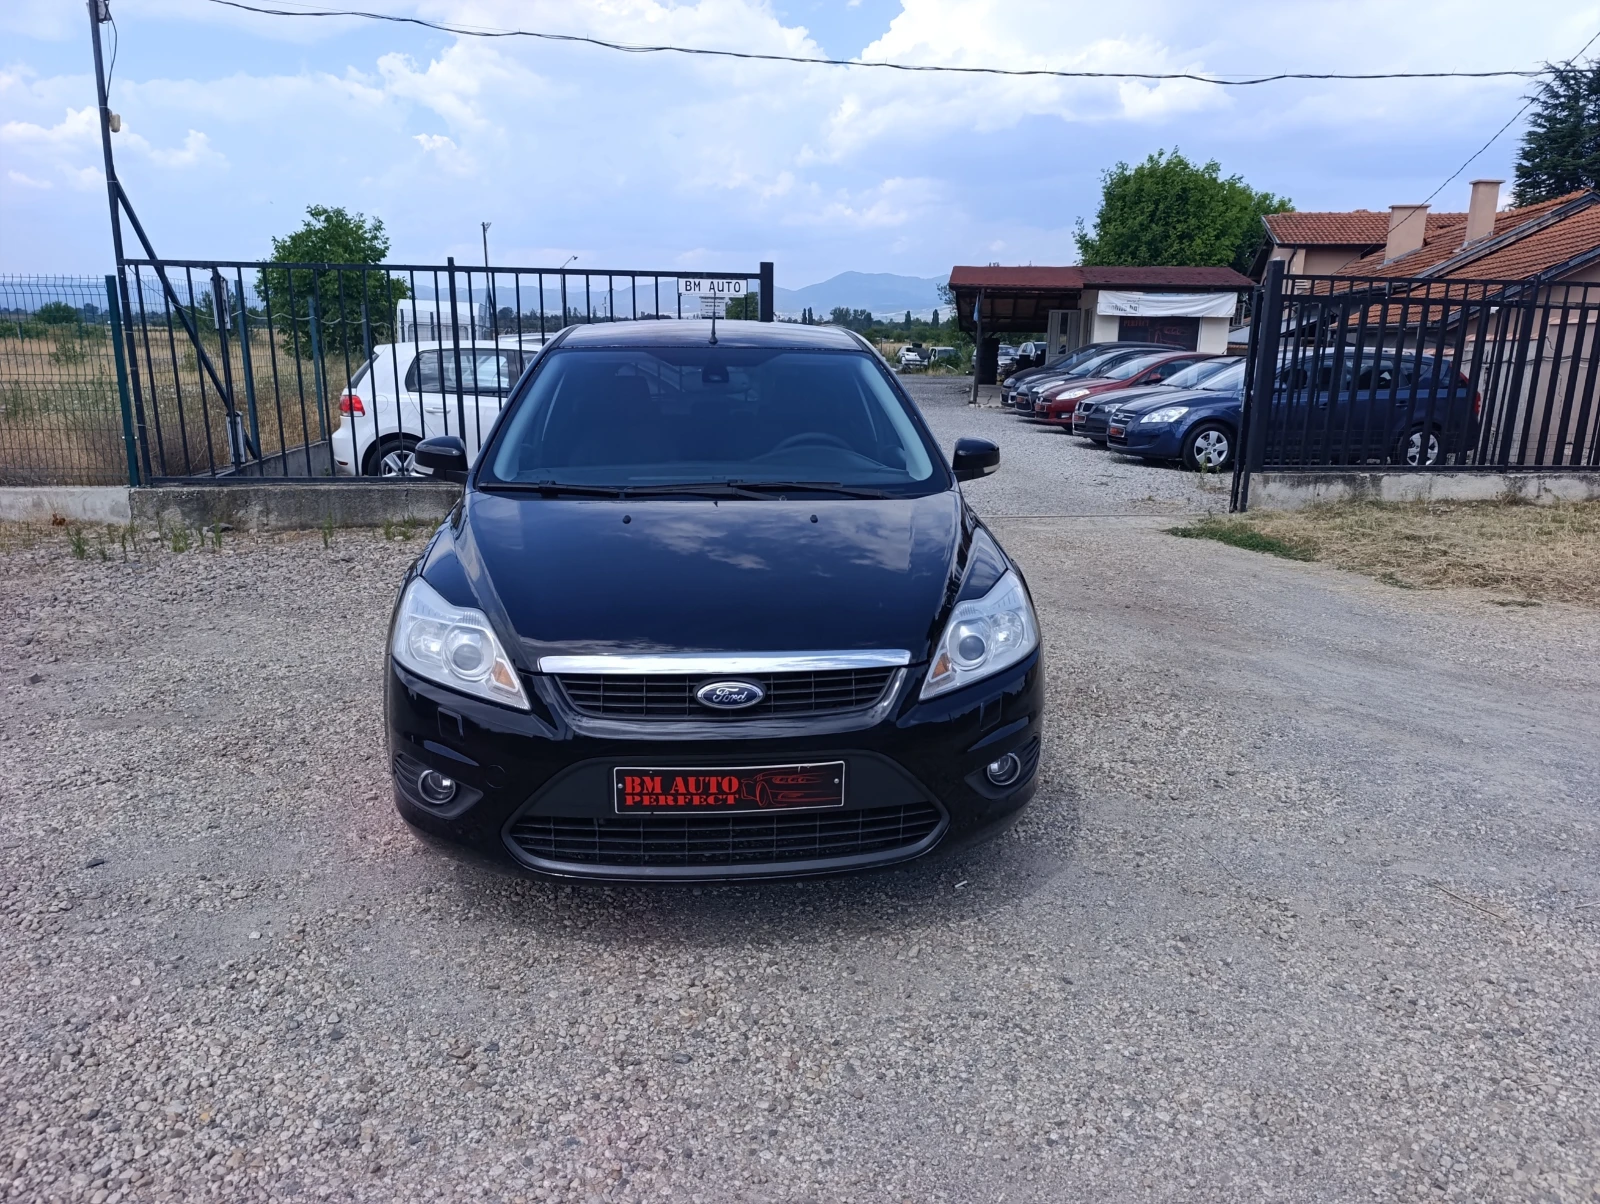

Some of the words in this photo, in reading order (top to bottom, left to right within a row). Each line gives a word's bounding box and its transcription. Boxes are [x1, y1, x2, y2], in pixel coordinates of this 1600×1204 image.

[684, 280, 701, 292] BM
[709, 281, 741, 293] AUTO
[712, 687, 747, 703] Ford
[624, 776, 662, 794] BM
[671, 776, 739, 794] AUTO
[625, 795, 739, 806] PERFECT
